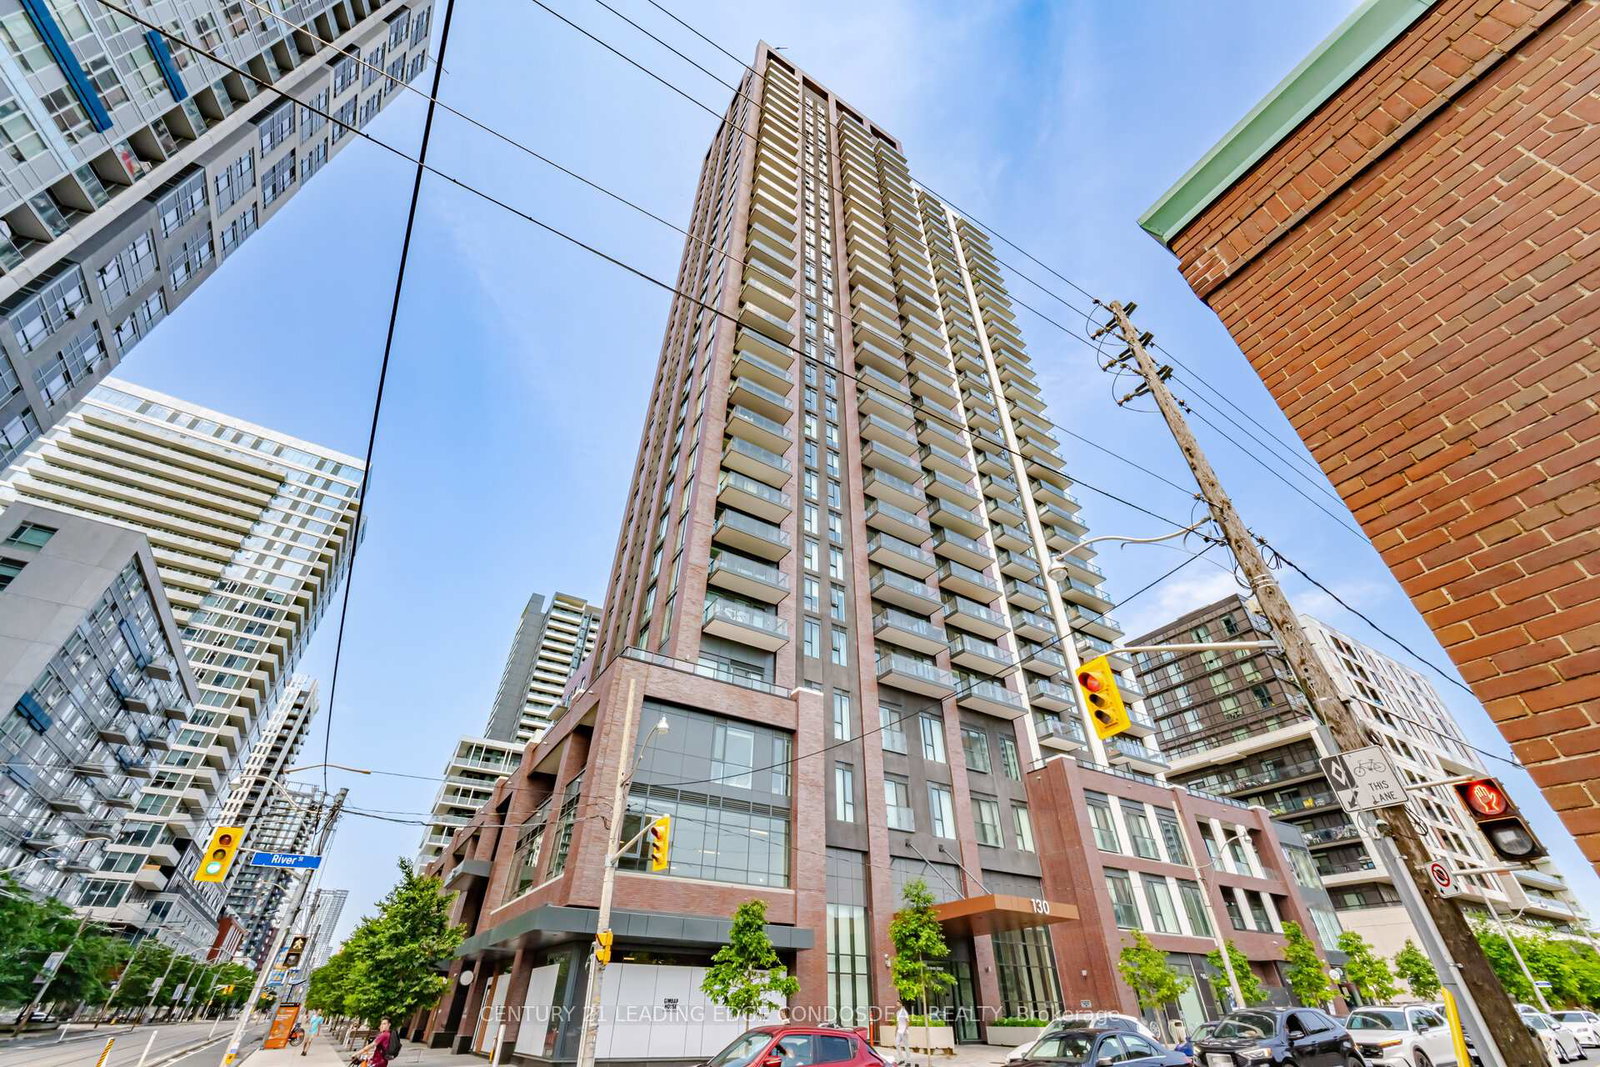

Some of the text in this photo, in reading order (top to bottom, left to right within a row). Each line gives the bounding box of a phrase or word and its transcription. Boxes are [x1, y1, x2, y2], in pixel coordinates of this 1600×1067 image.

[1368, 780, 1389, 791] THIS
[1372, 791, 1398, 805] LANE
[271, 854, 297, 865] River
[1030, 898, 1050, 915] 130
